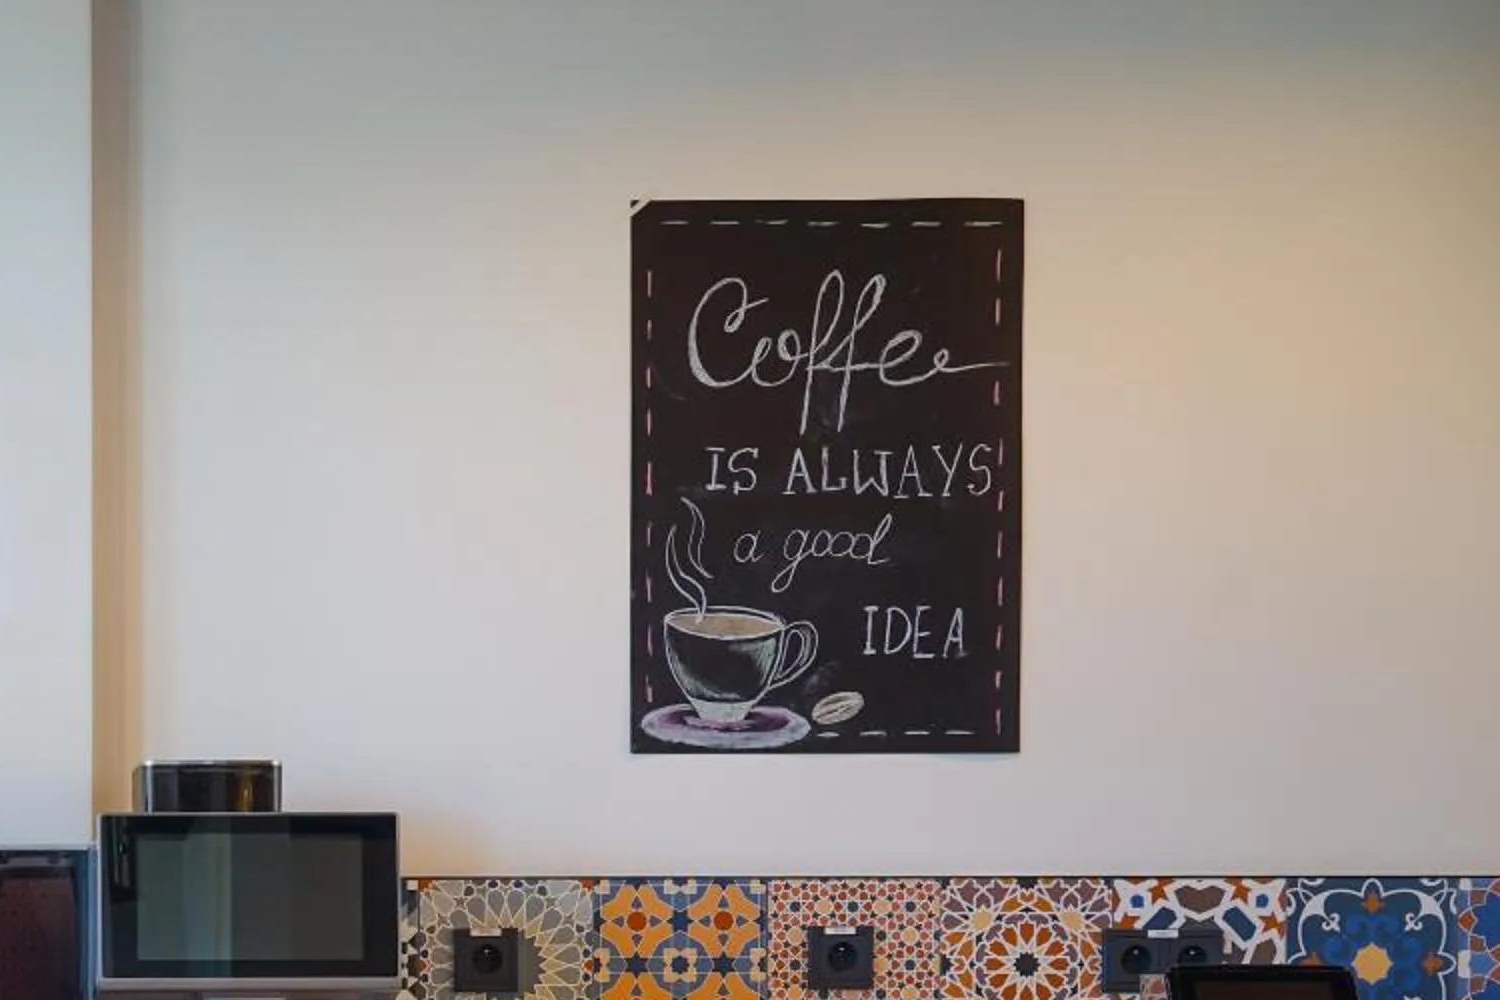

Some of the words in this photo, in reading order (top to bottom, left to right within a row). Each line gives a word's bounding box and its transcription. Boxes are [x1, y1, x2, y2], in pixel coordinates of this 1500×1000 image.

[687, 268, 1010, 435] Coffee
[704, 446, 760, 495] IS
[781, 442, 993, 499] ALWAYS
[733, 530, 764, 564] a
[770, 512, 892, 593] good
[860, 604, 970, 660] IDEA
